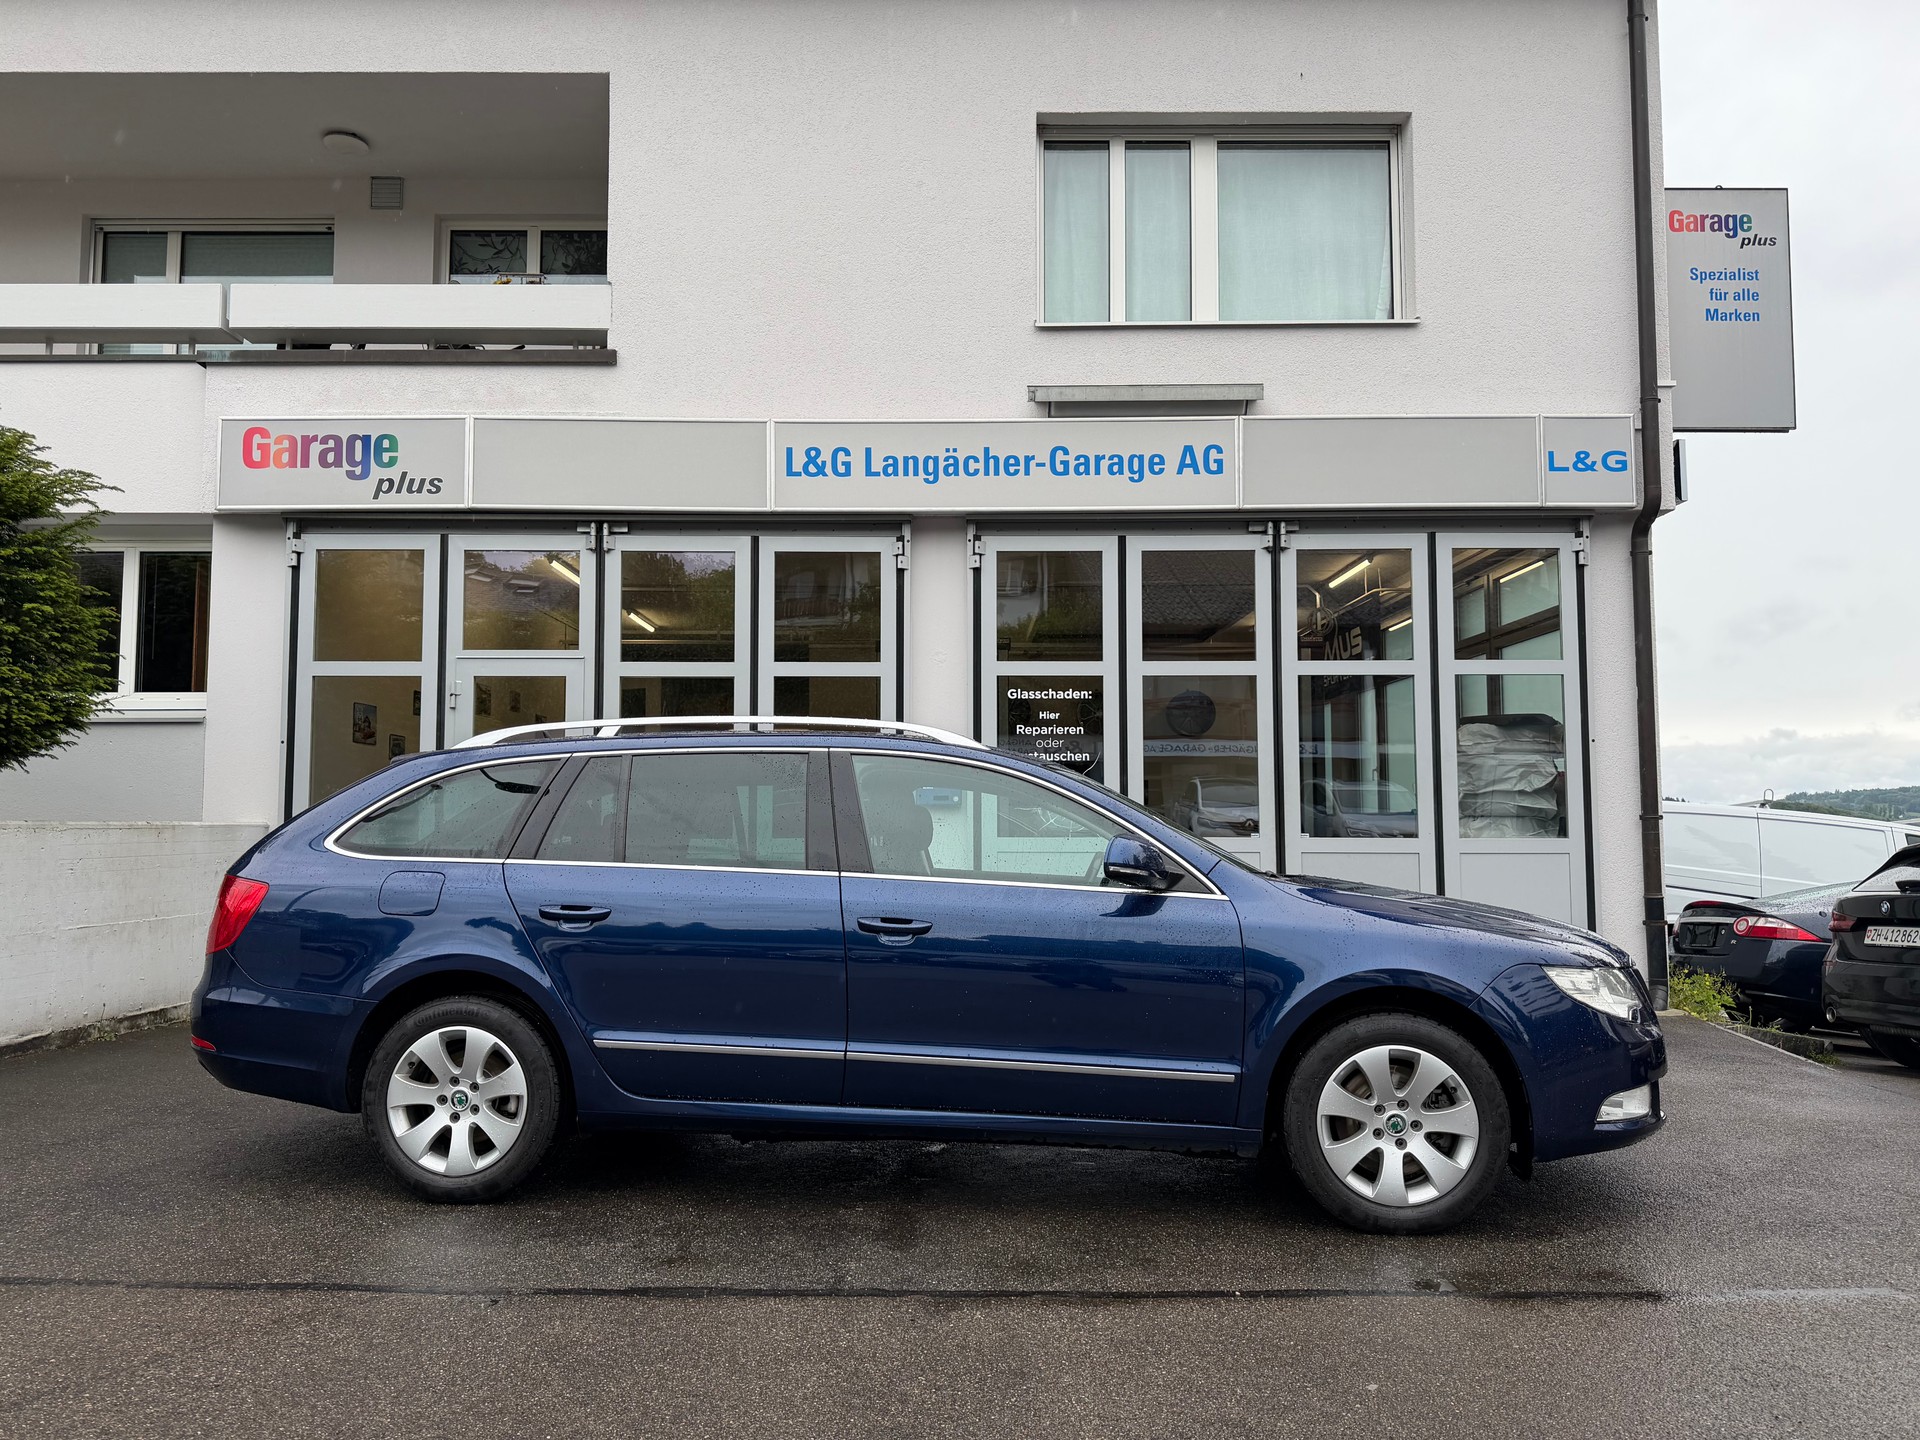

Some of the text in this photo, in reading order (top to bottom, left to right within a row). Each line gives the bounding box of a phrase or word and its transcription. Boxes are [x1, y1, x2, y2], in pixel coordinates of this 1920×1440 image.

[1668, 209, 1753, 239] Garage
[1739, 233, 1777, 250] plus
[1689, 267, 1760, 284] Spezialist
[1709, 287, 1760, 302] für alle
[1705, 308, 1761, 322] Marken
[242, 426, 399, 481] Garage
[1547, 450, 1628, 473] L&G
[785, 443, 1224, 485] L&G Langächer-Garage AG
[371, 470, 444, 501] plus
[1007, 688, 1093, 700] Glasschaden:
[1038, 711, 1061, 720] Hier
[1015, 724, 1085, 736] Reparieren
[1035, 737, 1065, 748] oder
[1025, 750, 1090, 761] tauschen
